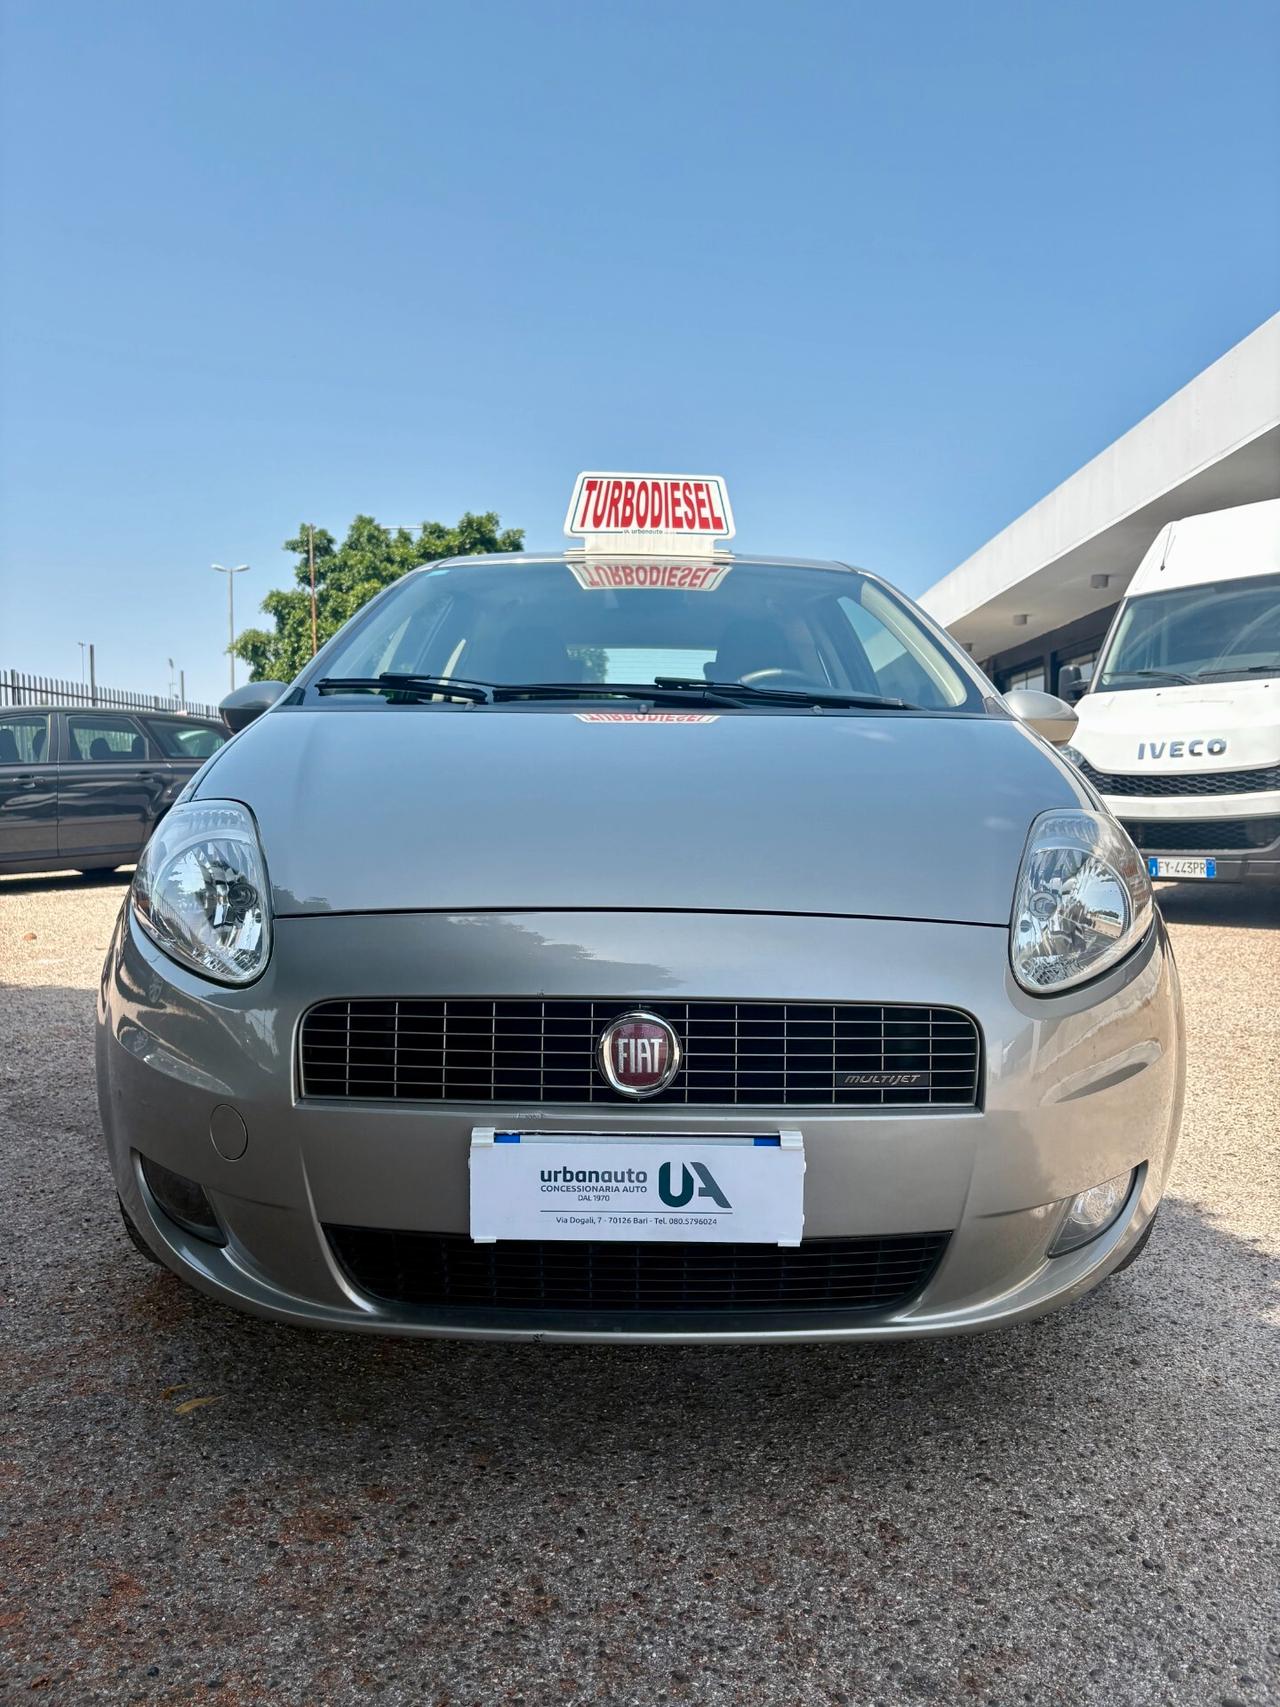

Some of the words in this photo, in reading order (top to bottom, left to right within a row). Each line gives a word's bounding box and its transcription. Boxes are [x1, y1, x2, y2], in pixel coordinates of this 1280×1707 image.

[580, 480, 723, 530] TURBODIESEL
[1137, 738, 1227, 760] IVECO
[618, 1038, 662, 1073] FIAT
[844, 1073, 921, 1086] MULTIJET
[540, 1166, 648, 1184] urbanauto
[540, 1184, 620, 1193] CONCESSIONARIA
[622, 1185, 648, 1193] AUTO
[577, 1194, 592, 1202] DAL
[593, 1194, 610, 1202] 1970
[556, 1216, 568, 1224] Via
[569, 1216, 596, 1227] Dogali,
[608, 1217, 632, 1225] 70126
[633, 1217, 648, 1225] Bari
[654, 1217, 667, 1225] Tel.
[668, 1217, 717, 1226] 080.5796024
